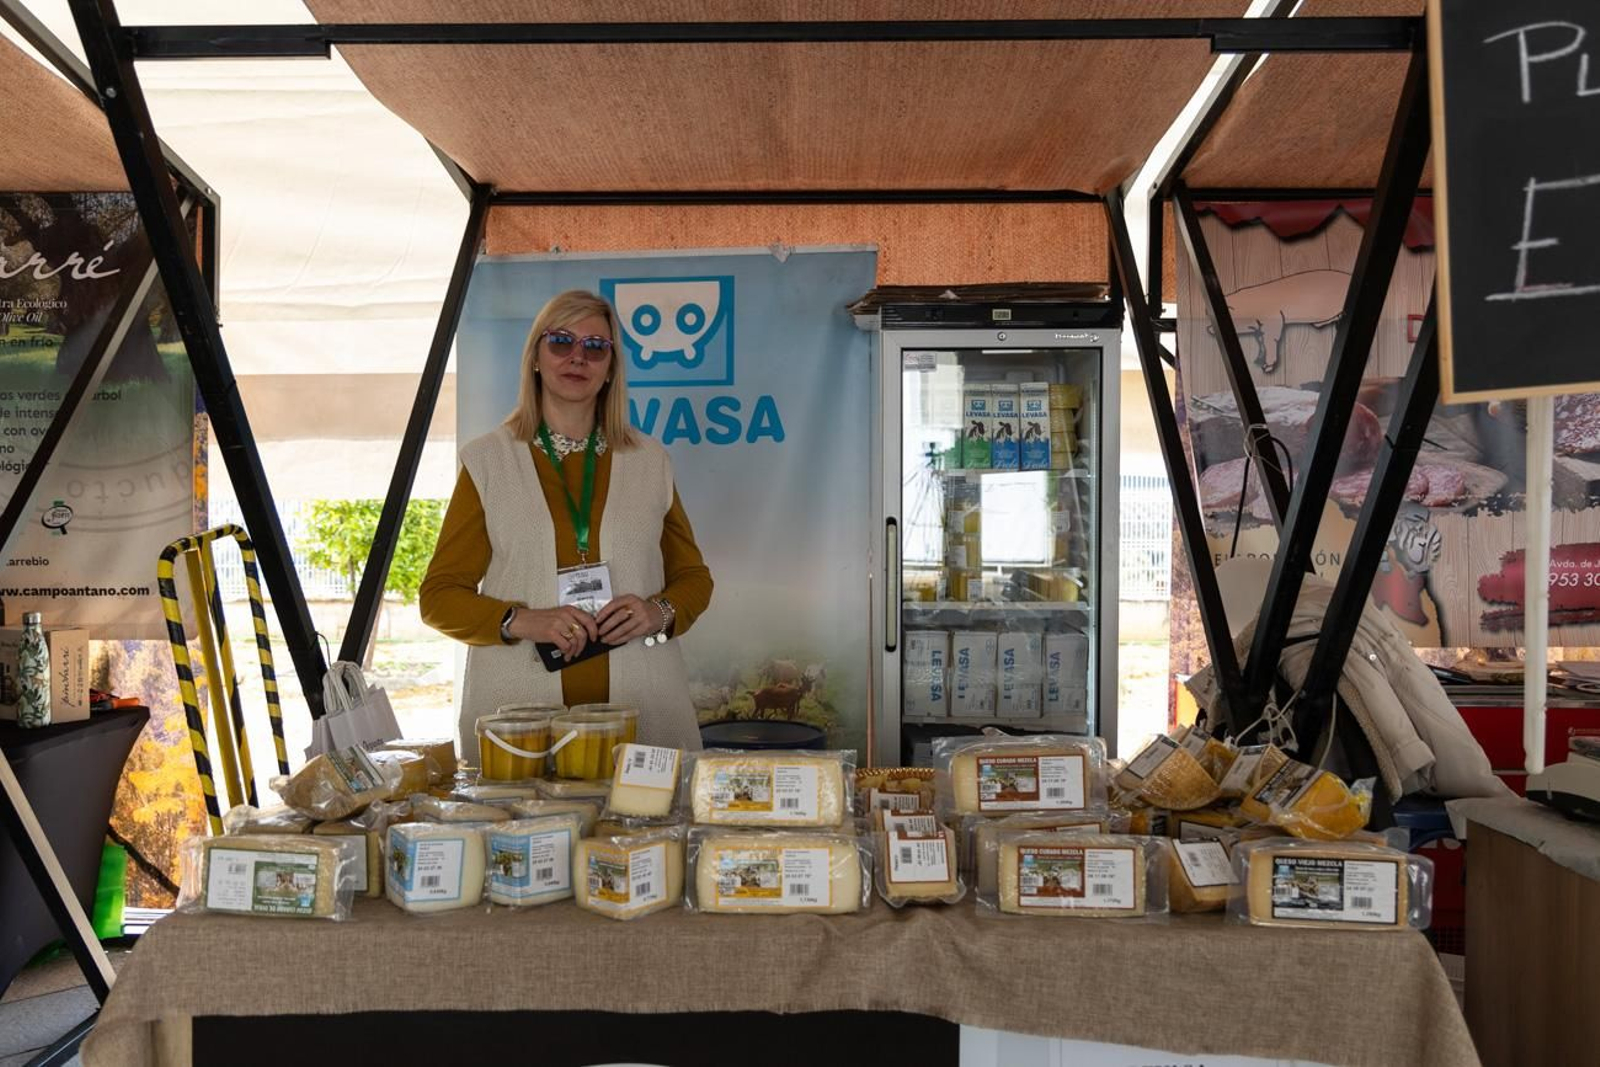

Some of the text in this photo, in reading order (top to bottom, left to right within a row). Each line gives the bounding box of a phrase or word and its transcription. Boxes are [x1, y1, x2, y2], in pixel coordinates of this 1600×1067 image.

[27, 311, 43, 322] Oil
[18, 389, 60, 401] verdes
[16, 405, 59, 418] intens
[628, 395, 786, 445] VASA
[4, 427, 26, 436] con
[0, 460, 31, 474] lógi
[5, 554, 50, 567] arrebio
[1580, 559, 1593, 569] de
[1548, 572, 1580, 587] 953
[930, 650, 943, 702] LEVASA
